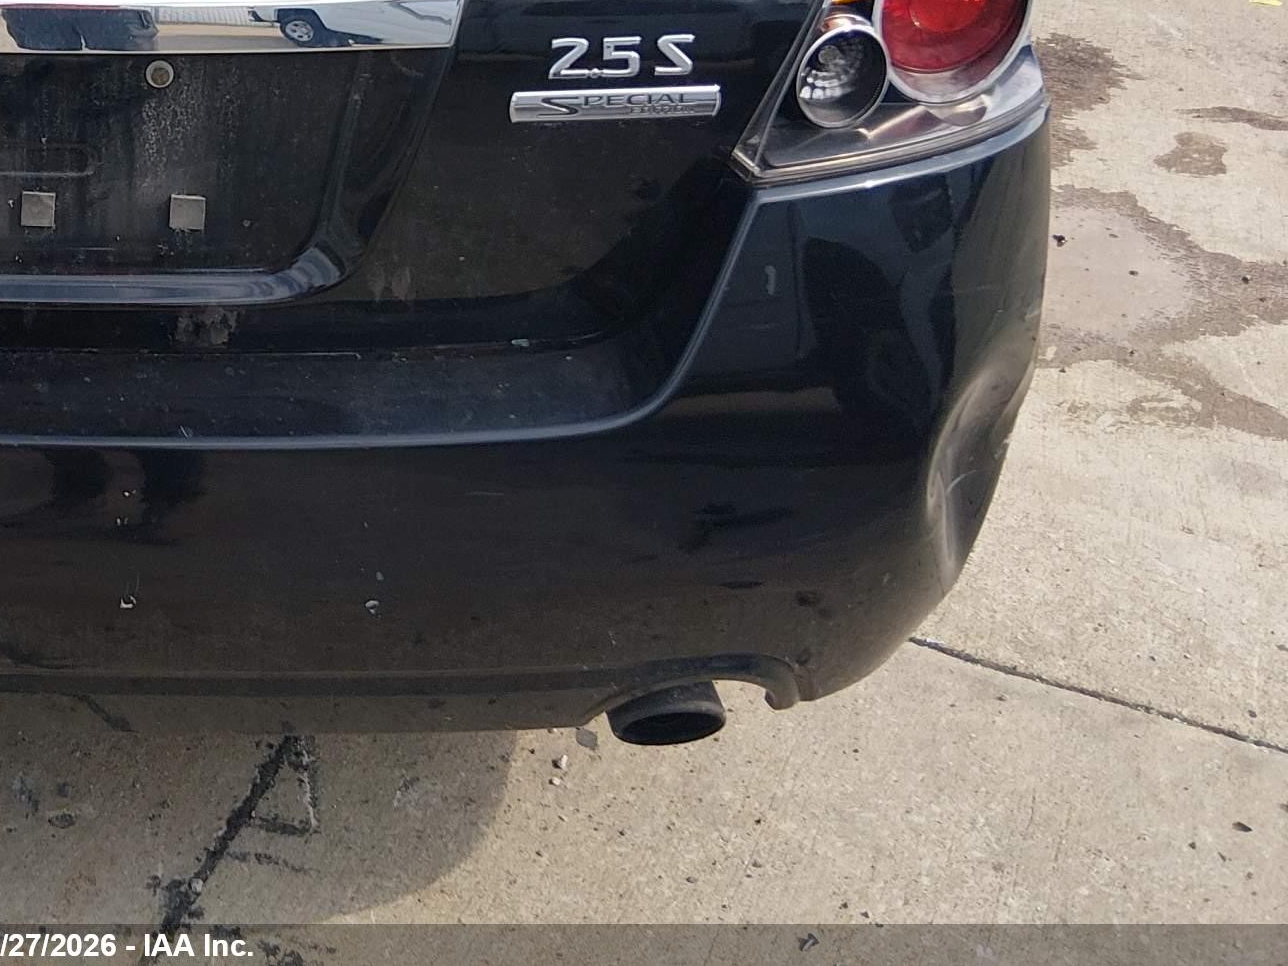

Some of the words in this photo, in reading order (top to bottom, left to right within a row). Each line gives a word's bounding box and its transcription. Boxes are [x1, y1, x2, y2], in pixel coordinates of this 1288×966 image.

[548, 37, 643, 79] 2.5
[654, 34, 696, 76] S
[536, 93, 692, 117] SPECIAL
